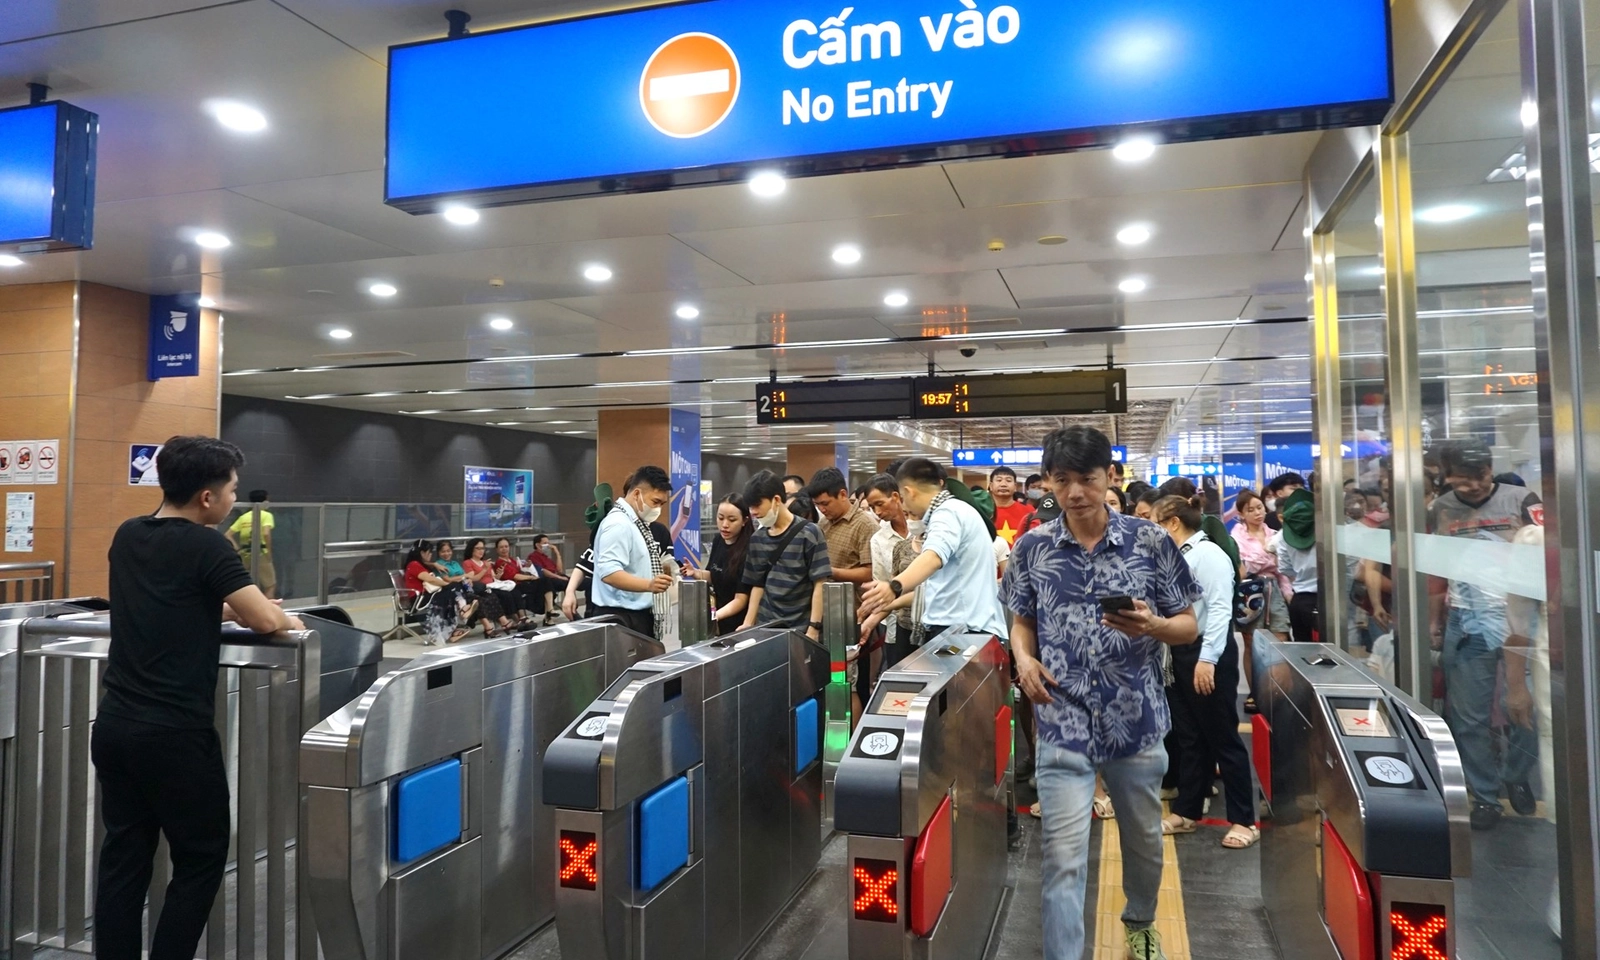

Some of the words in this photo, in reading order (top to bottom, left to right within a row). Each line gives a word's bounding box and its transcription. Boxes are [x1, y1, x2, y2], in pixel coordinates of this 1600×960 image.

[782, 6, 901, 70] Cấm
[919, 0, 1020, 53] vào
[782, 87, 834, 126] No
[847, 77, 954, 119] Entry
[921, 393, 953, 405] 19:57
[1112, 381, 1120, 401] 1
[760, 395, 771, 413] 2
[1225, 474, 1240, 490] MỘT
